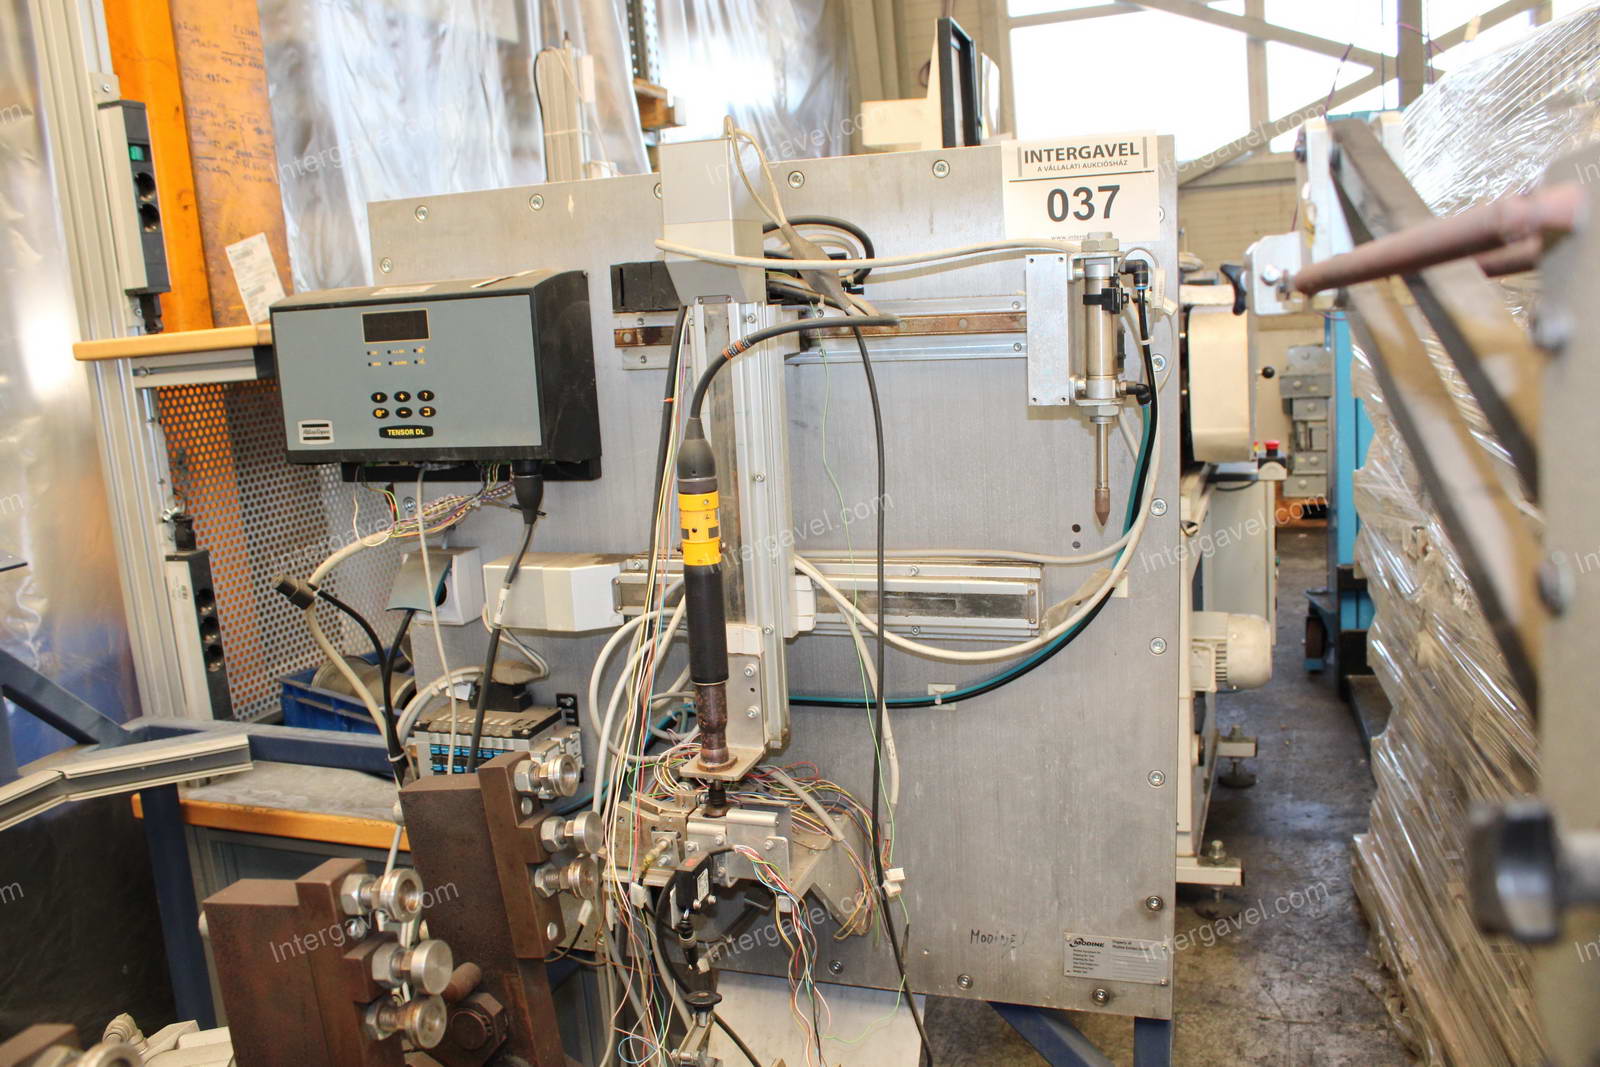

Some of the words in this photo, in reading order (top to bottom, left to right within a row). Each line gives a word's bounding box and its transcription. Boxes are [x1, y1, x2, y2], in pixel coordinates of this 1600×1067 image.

[1024, 142, 1140, 164] INTERGAVEL
[1047, 184, 1121, 222] 037
[387, 428, 414, 436] TENSOR
[415, 428, 425, 436] DL
[1072, 939, 1105, 948] MODINE
